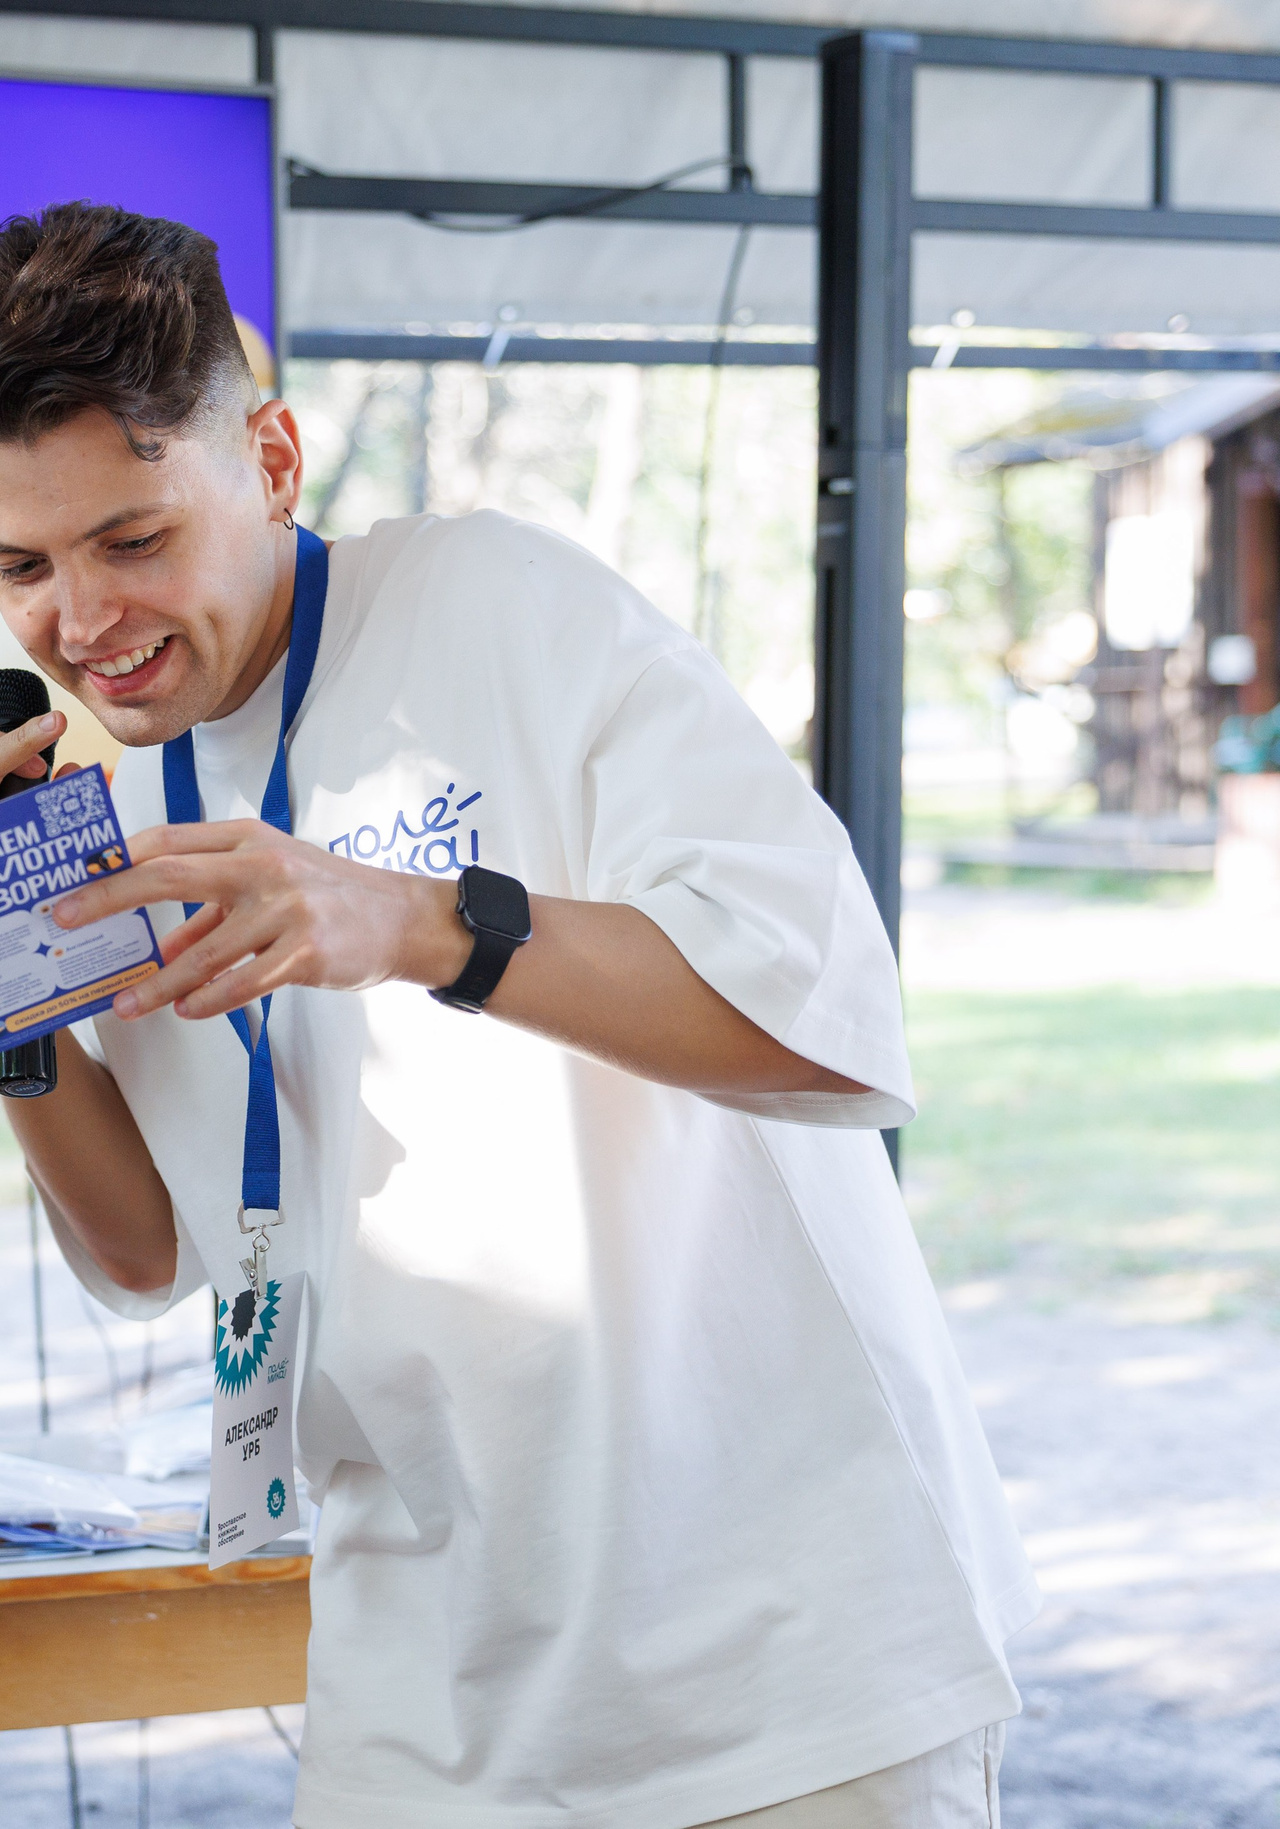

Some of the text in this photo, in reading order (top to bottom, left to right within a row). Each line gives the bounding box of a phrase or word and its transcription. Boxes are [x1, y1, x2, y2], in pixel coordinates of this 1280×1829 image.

[14, 1009, 45, 1026] скидка
[46, 1004, 58, 1014] до
[58, 996, 77, 1008] 50%
[78, 992, 90, 1001] на
[90, 979, 123, 997] первый
[224, 1406, 279, 1447] АЛЕКСАНДР
[242, 1437, 261, 1462] УРБ
[217, 1511, 247, 1531] Ярославское
[217, 1524, 238, 1539] книжное
[217, 1529, 245, 1547] обострение
